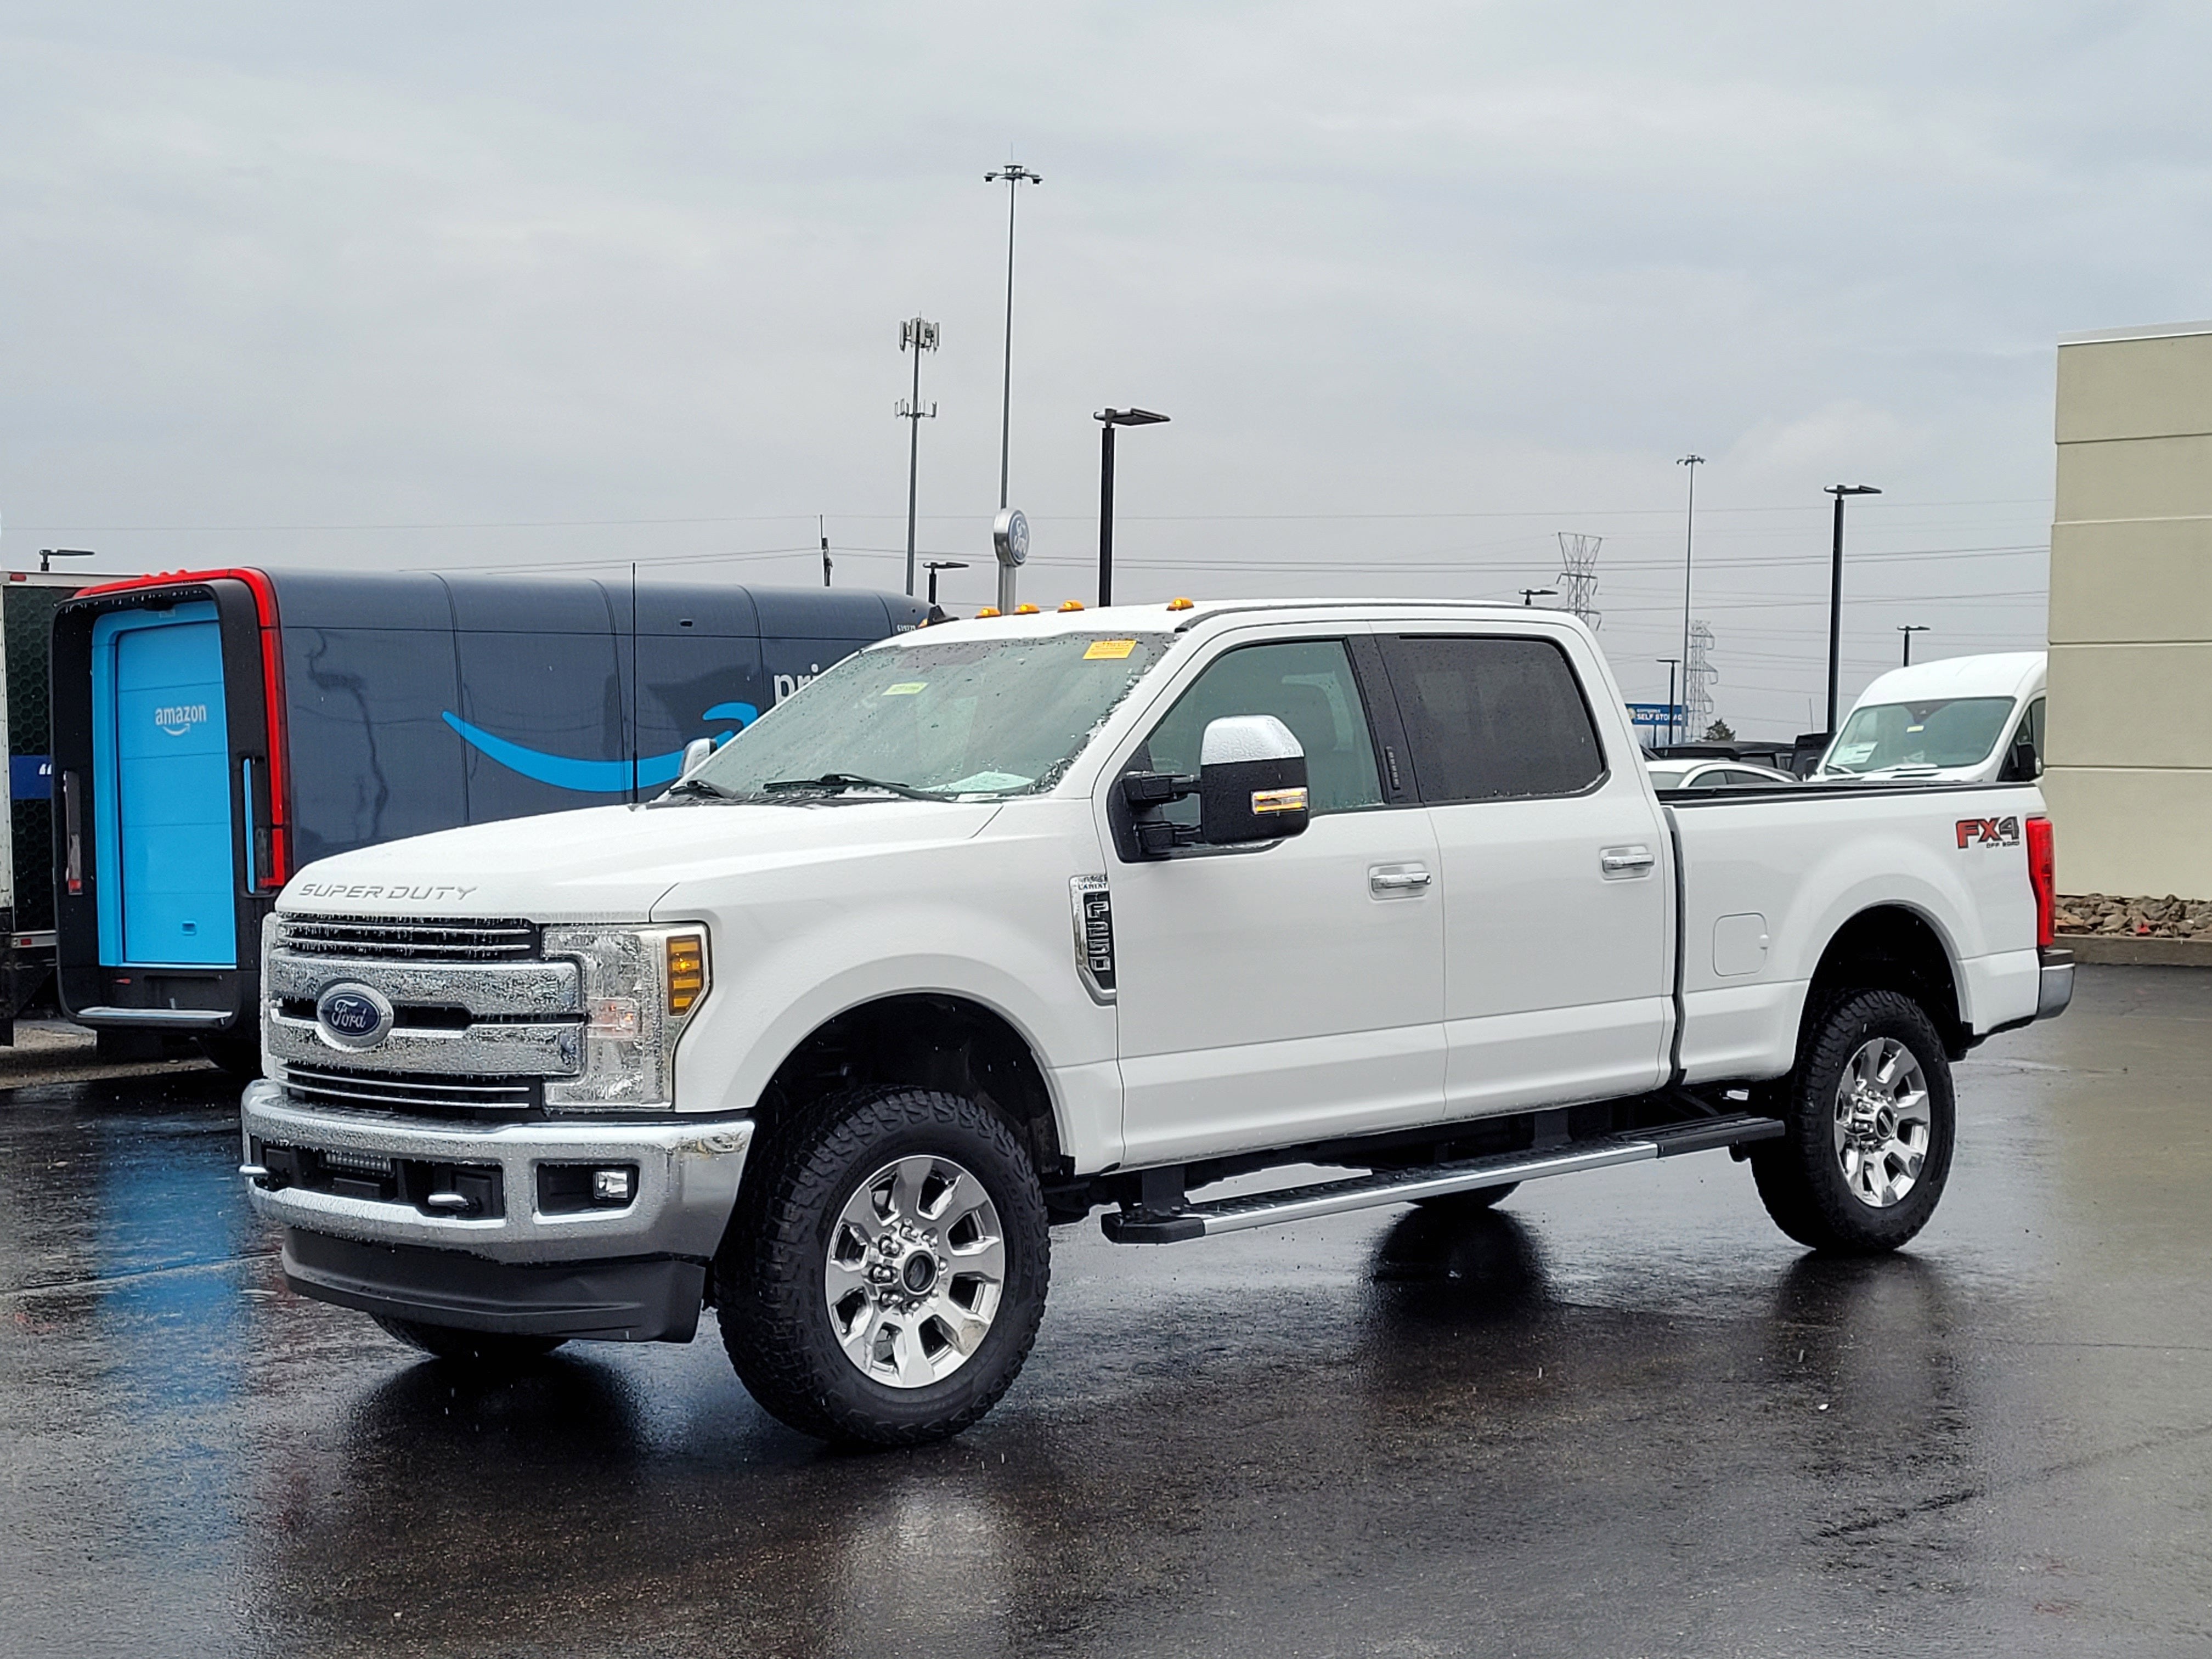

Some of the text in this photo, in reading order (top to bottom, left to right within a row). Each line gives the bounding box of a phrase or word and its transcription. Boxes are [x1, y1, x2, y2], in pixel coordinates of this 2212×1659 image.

[155, 705, 206, 725] amazon
[1956, 816, 2019, 849] FX4
[299, 883, 478, 901] SUPER DUTY
[331, 999, 368, 1029] Ford
